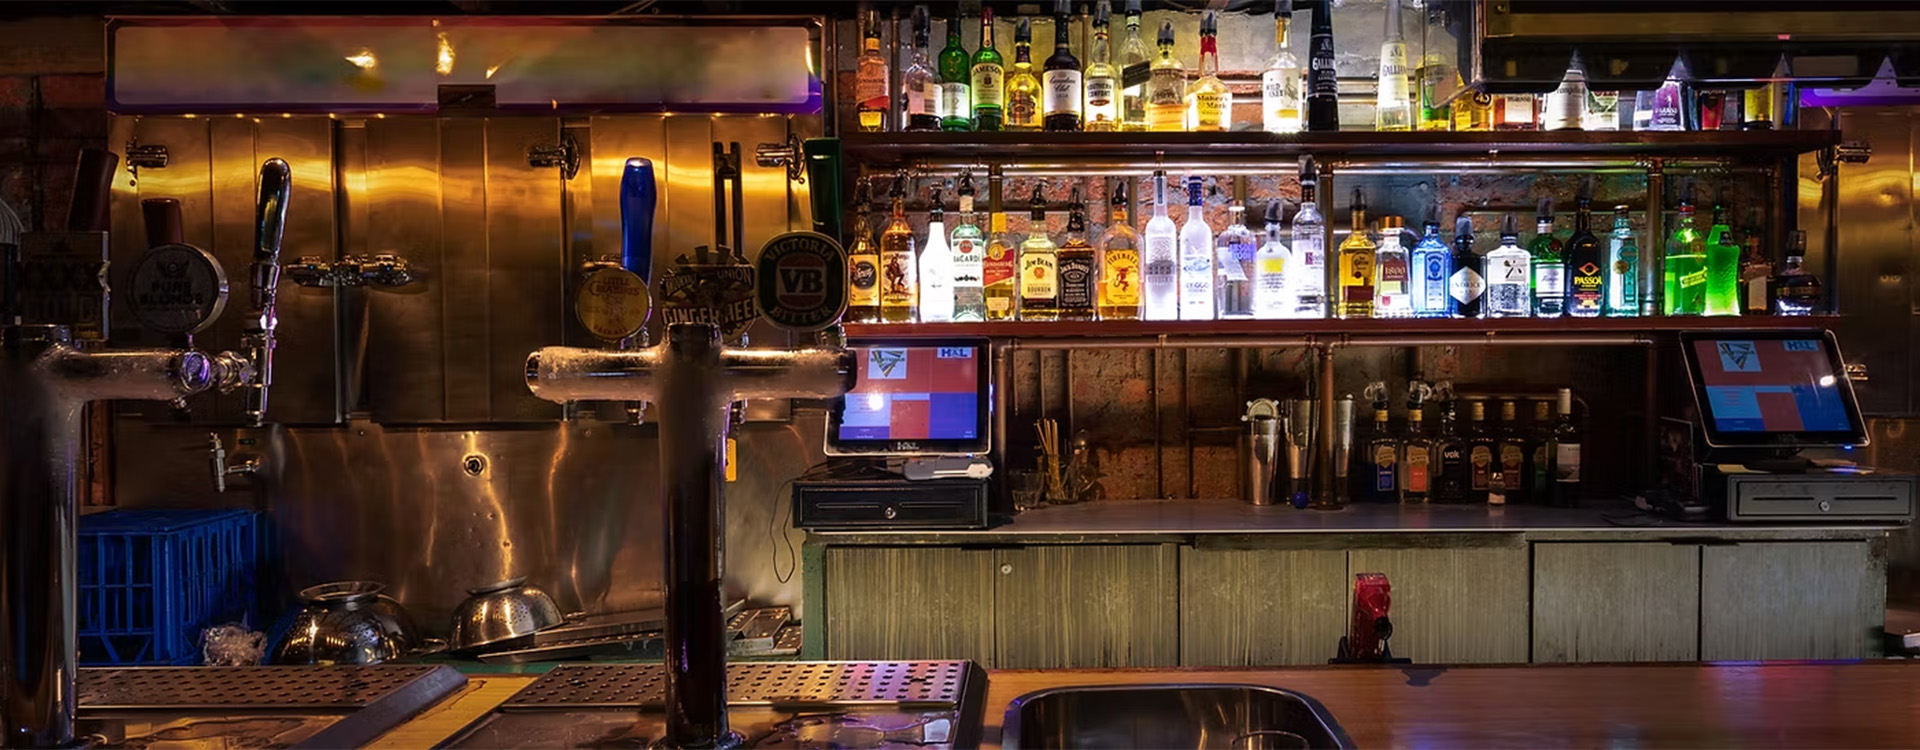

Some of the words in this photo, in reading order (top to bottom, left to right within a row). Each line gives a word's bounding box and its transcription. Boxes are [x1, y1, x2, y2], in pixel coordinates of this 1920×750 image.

[763, 238, 835, 262] VICTORIA
[603, 276, 629, 286] LITTLE
[716, 268, 752, 287] UNION
[779, 269, 822, 293] VB
[661, 307, 721, 326] GINGER
[769, 306, 834, 325] BITTER
[941, 348, 968, 357] H&L
[1442, 450, 1460, 460] vok
